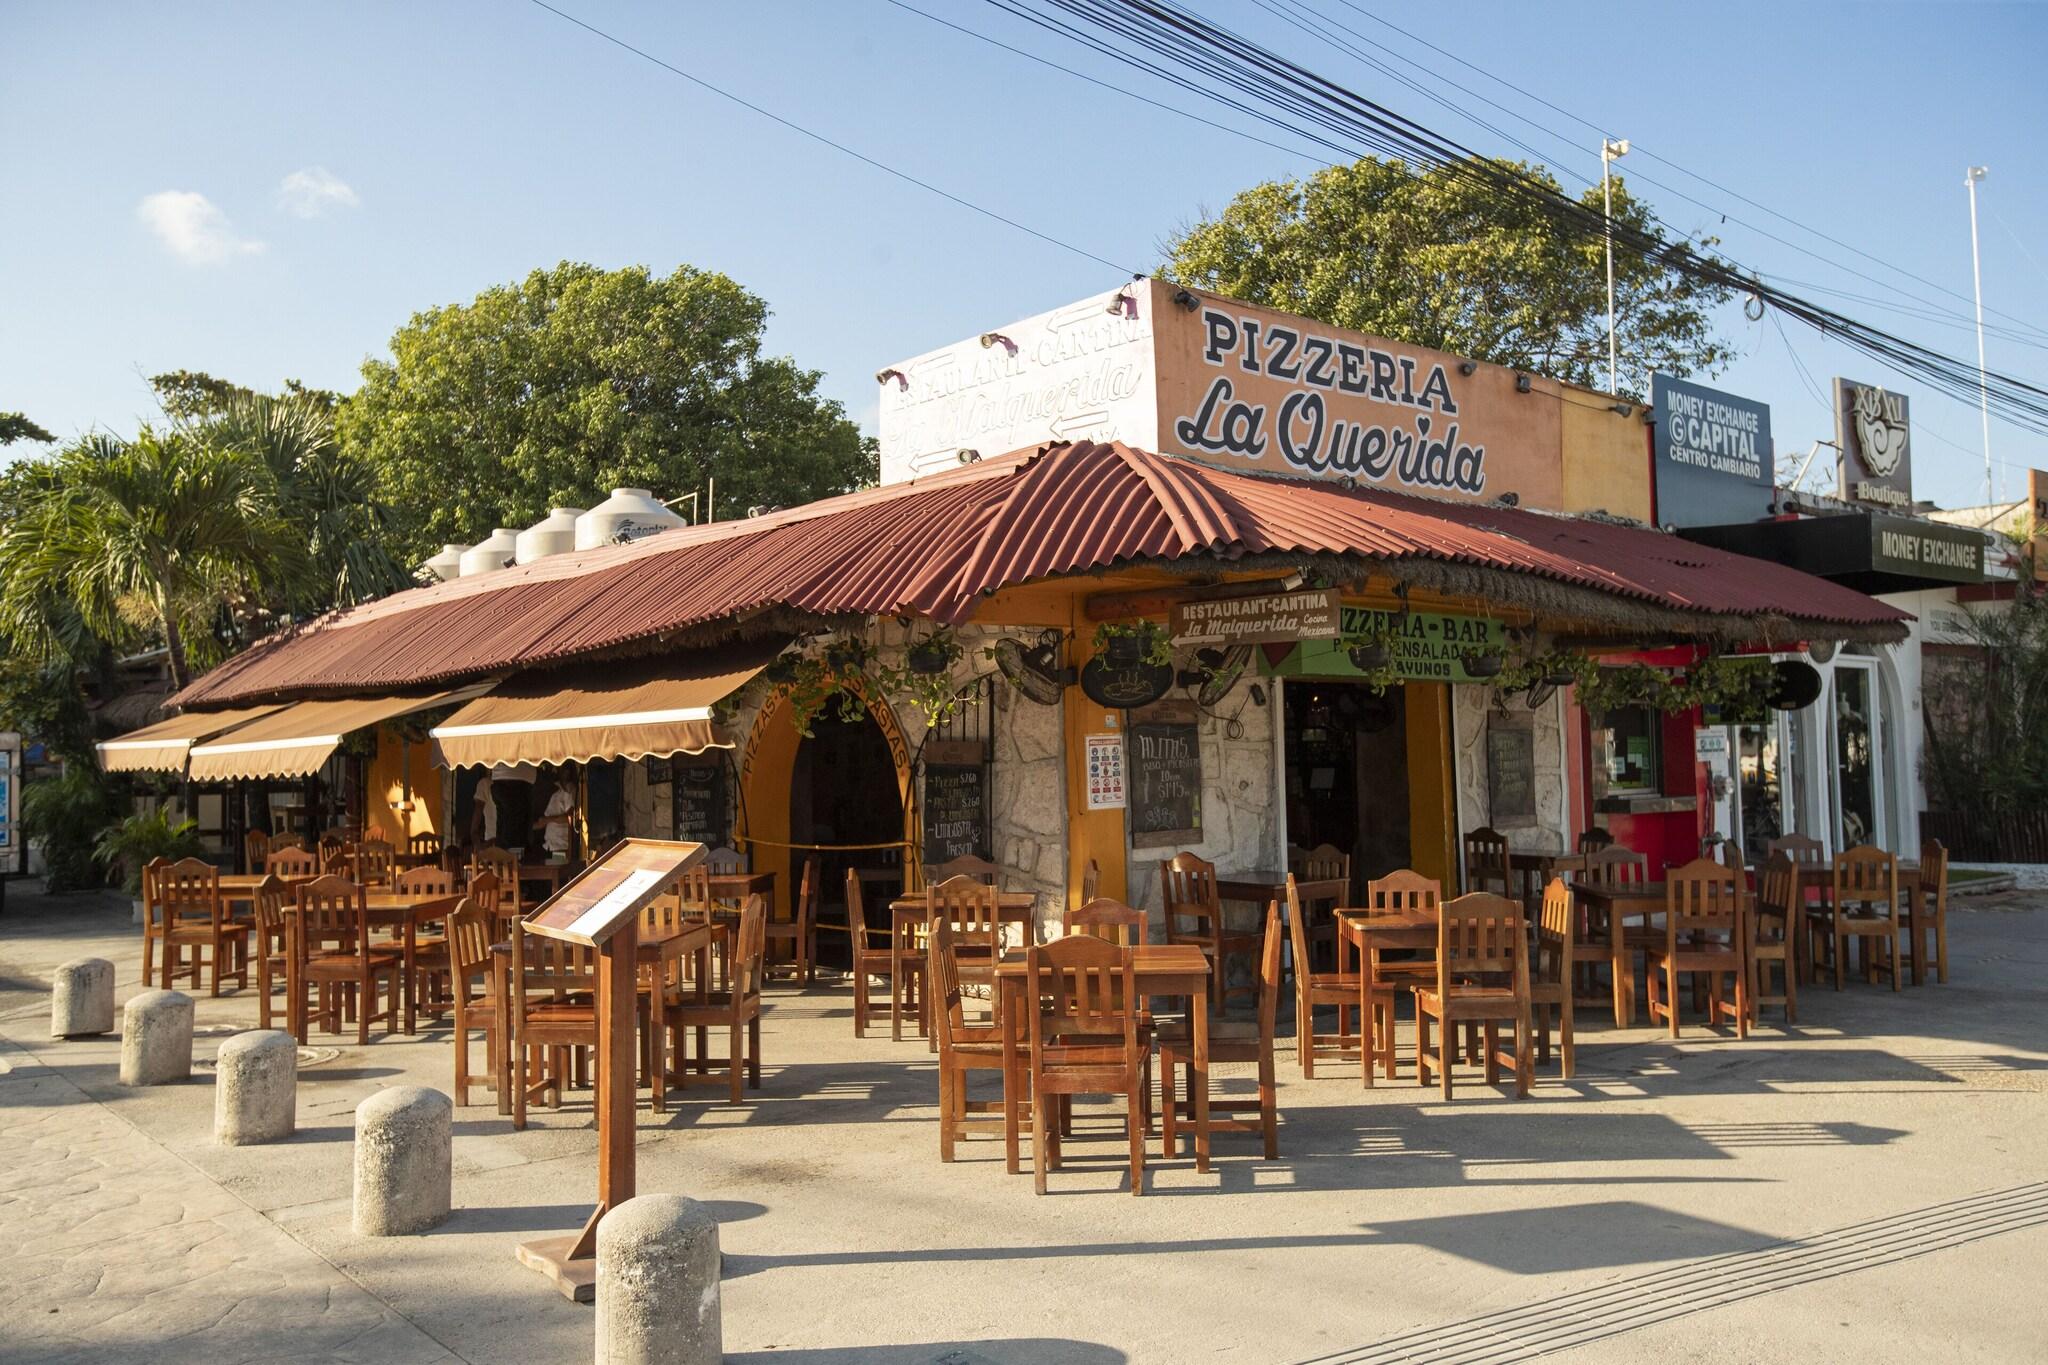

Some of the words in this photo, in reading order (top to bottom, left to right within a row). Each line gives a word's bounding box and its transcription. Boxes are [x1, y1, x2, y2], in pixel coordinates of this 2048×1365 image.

[1203, 308, 1458, 416] PIZZERIA
[1667, 390, 1704, 418] MONEY
[1706, 401, 1759, 433] EXCHANGE
[1177, 378, 1266, 457] La
[1278, 391, 1485, 493] Querida
[1687, 418, 1760, 462] CAPITAL
[1670, 445, 1708, 468] CENTRO
[1710, 455, 1761, 479] CAMBIARIO
[1860, 481, 1909, 508] Boutique
[1882, 531, 1920, 561] MONEY
[1923, 538, 1976, 569] EXCHANGE
[1183, 593, 1328, 620] RESTAURANT-CANTINA
[1304, 614, 1328, 624] Cocina
[1185, 621, 1201, 637] La
[1206, 615, 1300, 639] Malquerida
[1298, 626, 1335, 638] Mexicana
[743, 700, 776, 774] PIZZAS
[870, 701, 907, 769] ASTAS
